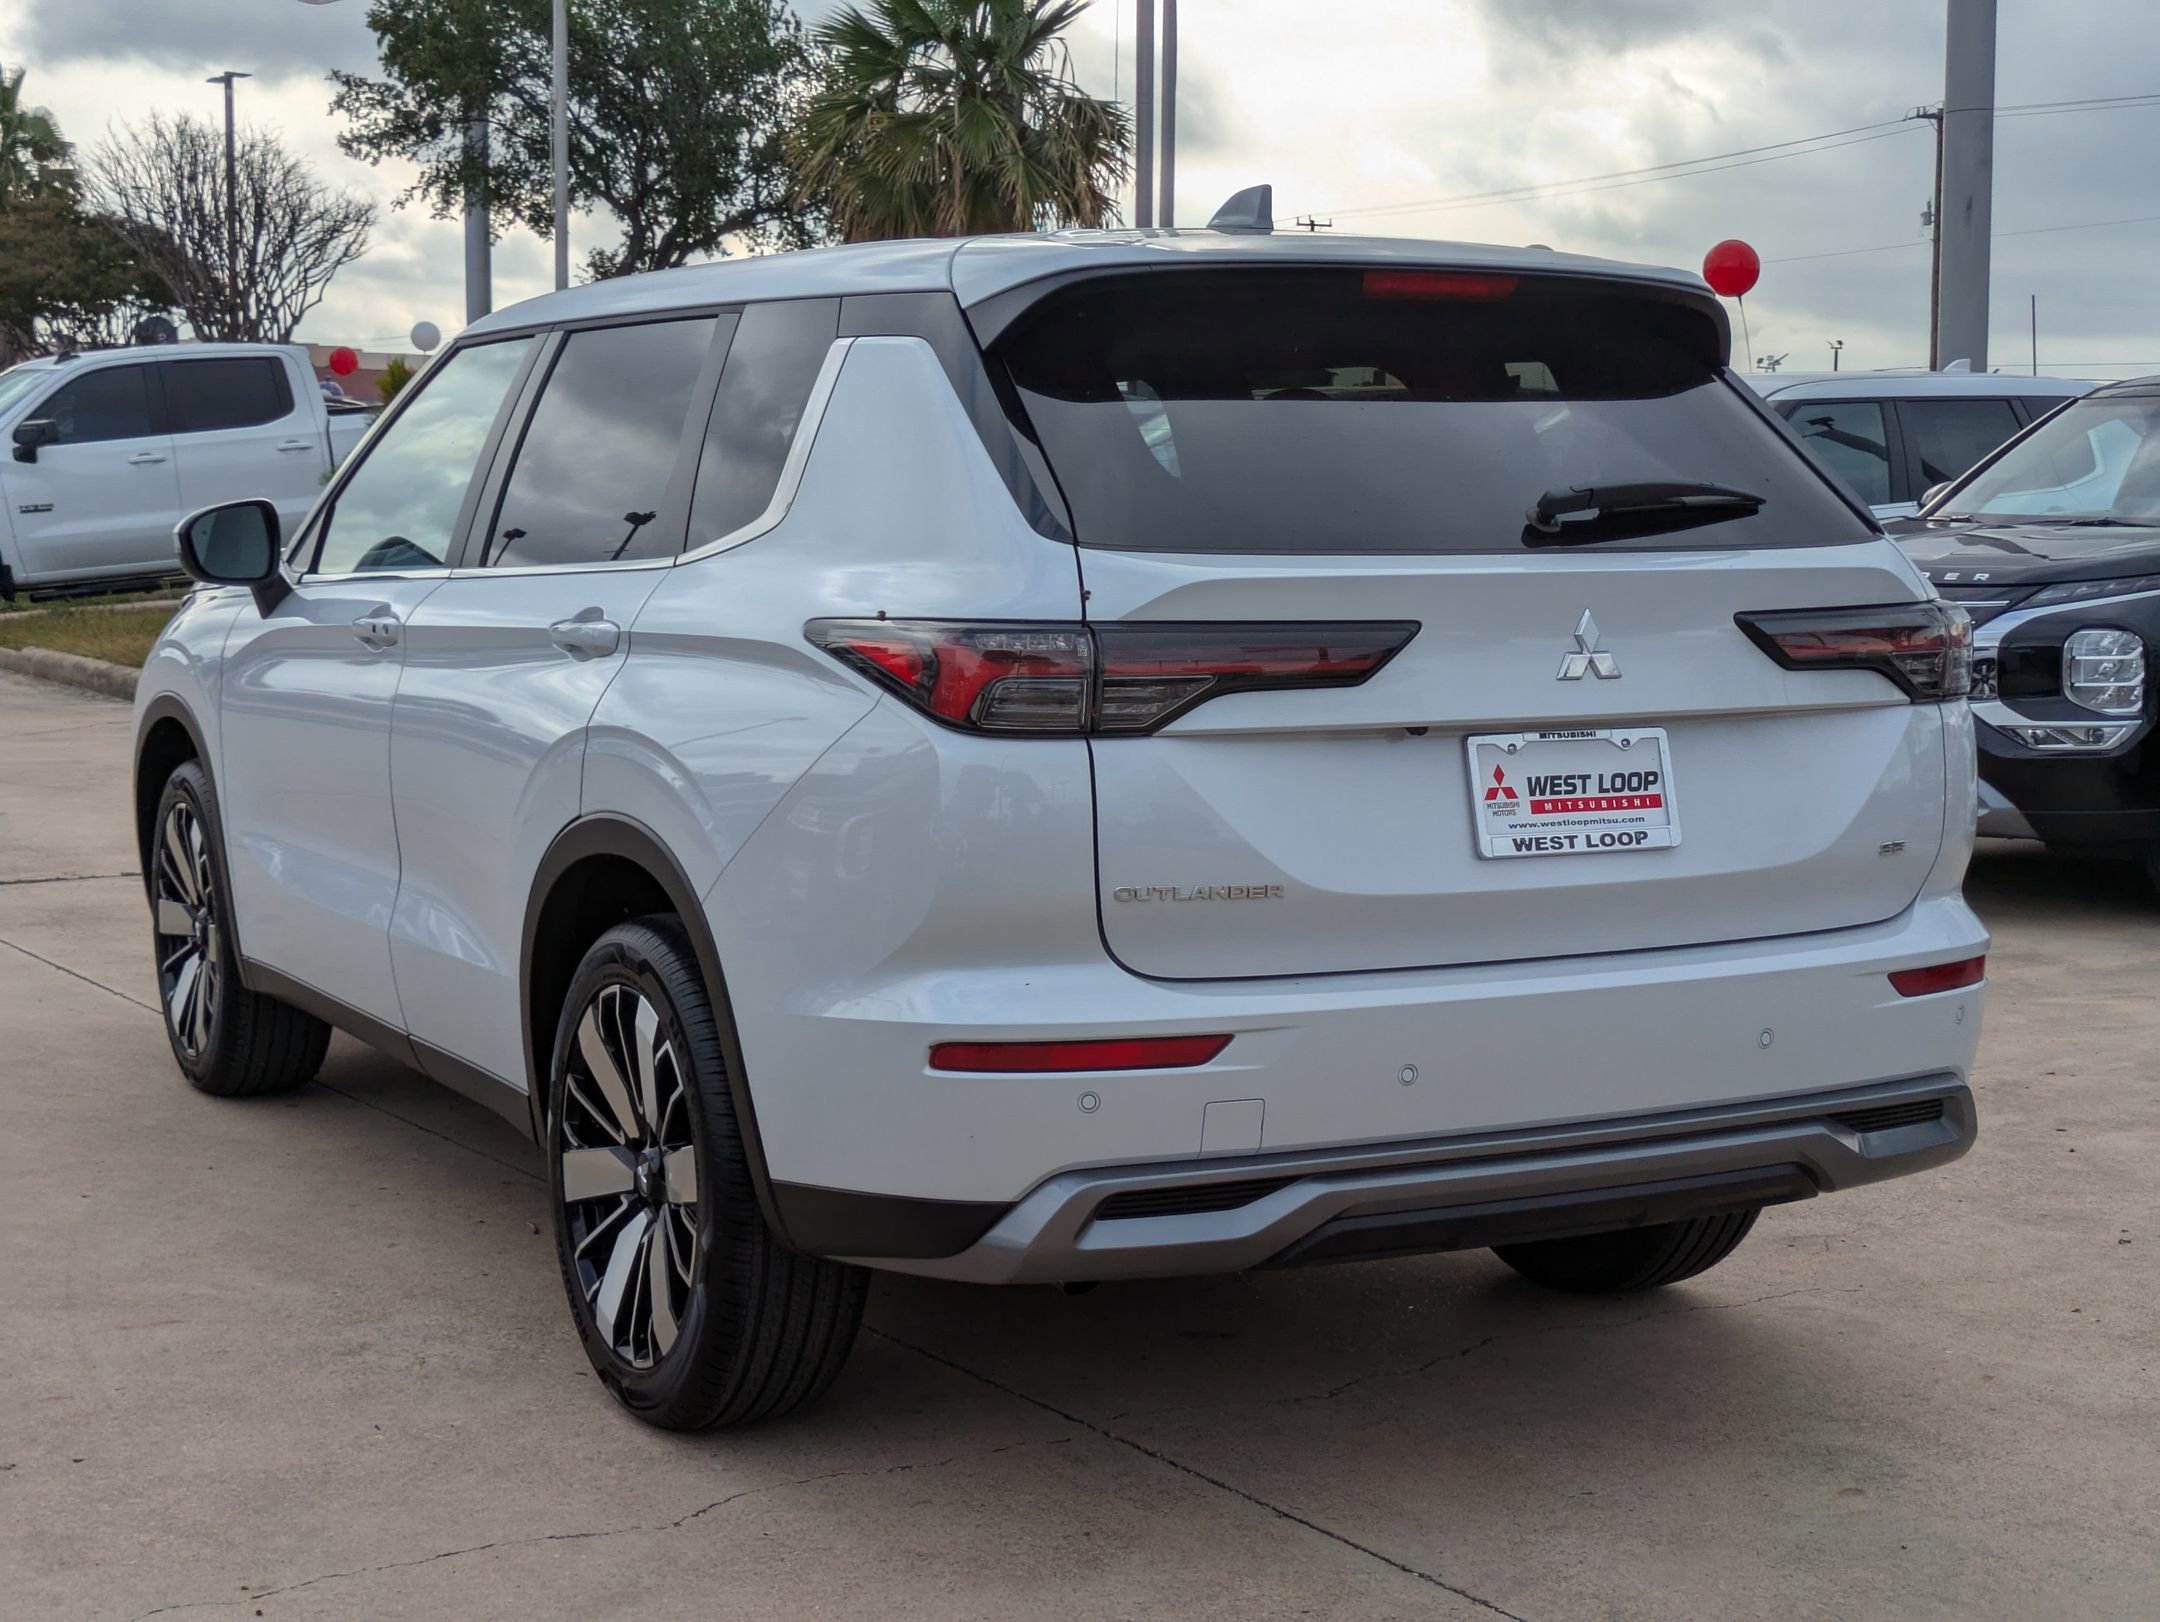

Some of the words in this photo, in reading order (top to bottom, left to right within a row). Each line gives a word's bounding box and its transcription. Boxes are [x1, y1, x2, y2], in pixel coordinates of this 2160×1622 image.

[1538, 731, 1597, 740] MITSUBISHI
[1527, 774, 1592, 797] WEST
[1598, 771, 1659, 794] LOOP
[1544, 798, 1651, 811] MITSUBISHI
[1492, 809, 1517, 817] MOTORS
[1508, 816, 1645, 830] www.westloopmitsu.com
[1512, 835, 1579, 853] WEST
[1585, 831, 1649, 848] LOOP
[1113, 884, 1285, 902] OUTLANDER
